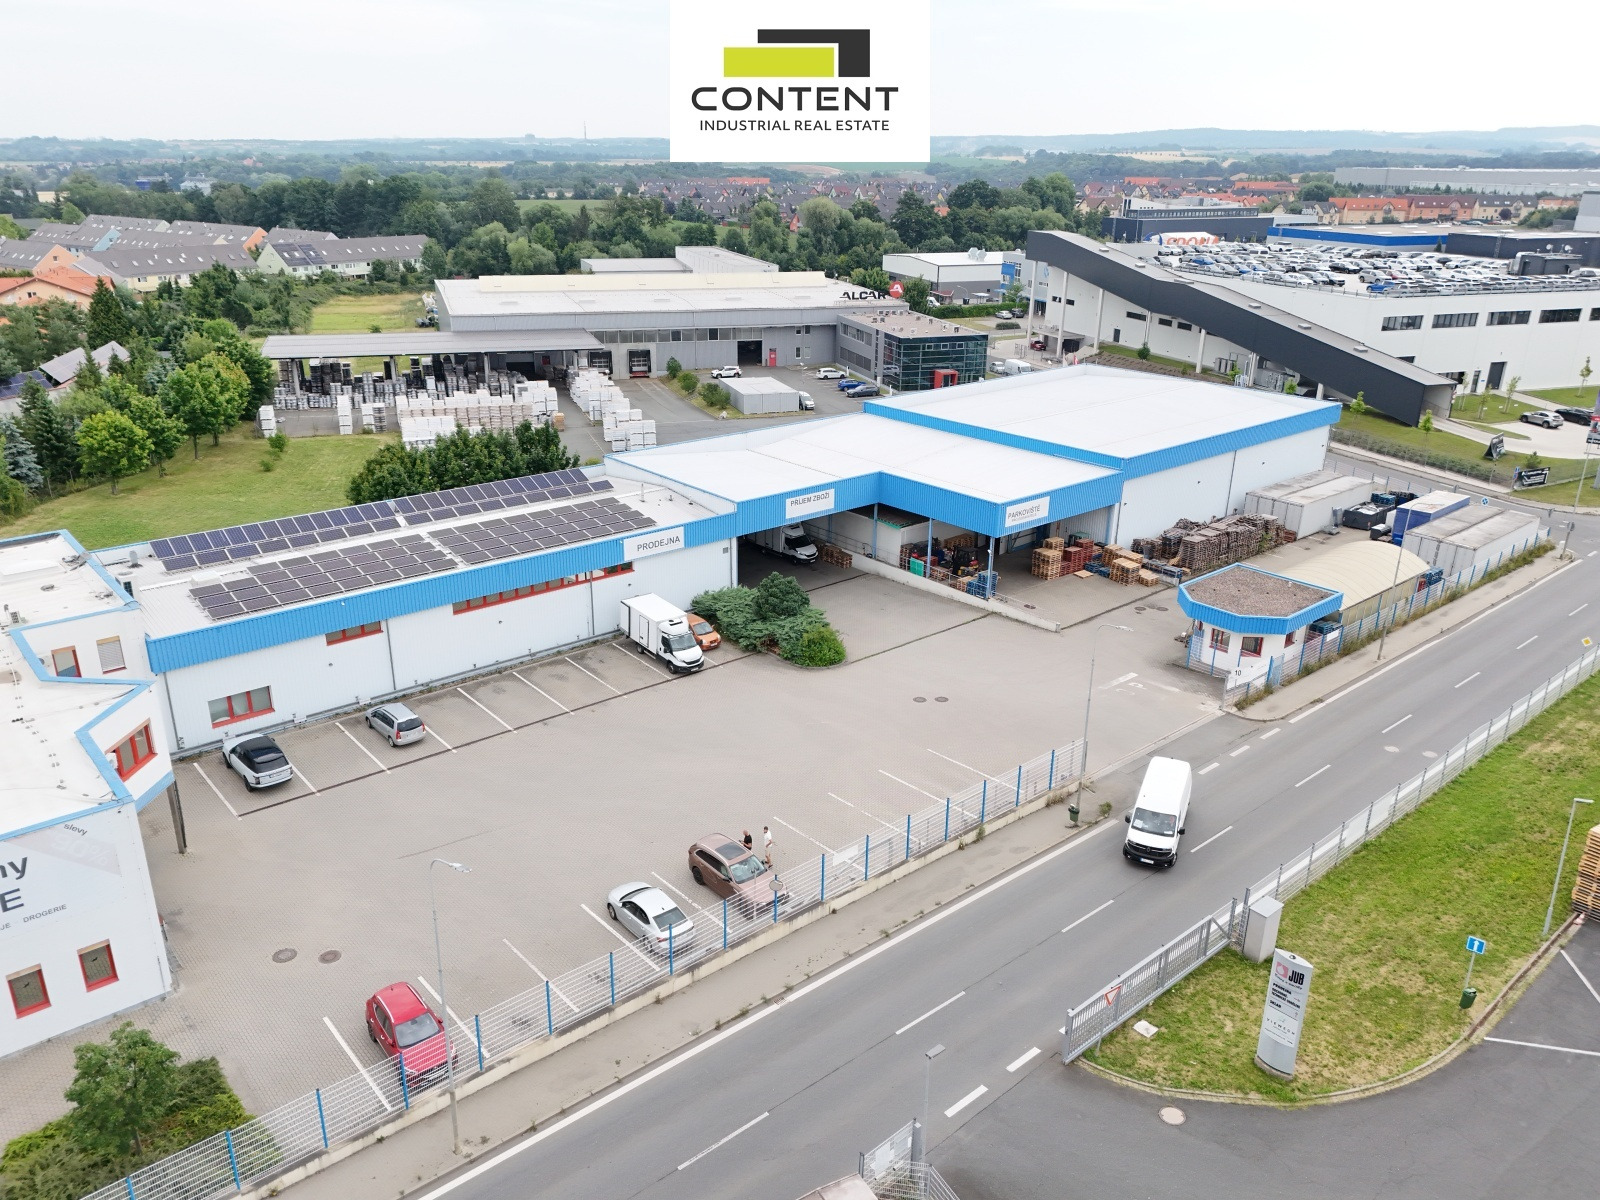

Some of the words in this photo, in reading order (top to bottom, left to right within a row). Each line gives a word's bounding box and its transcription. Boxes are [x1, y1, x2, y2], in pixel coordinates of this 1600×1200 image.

[839, 291, 887, 300] ALCAR
[636, 535, 681, 552] PRODEJNA
[23, 904, 67, 923] DROGERIE
[1288, 969, 1305, 986] JUB
